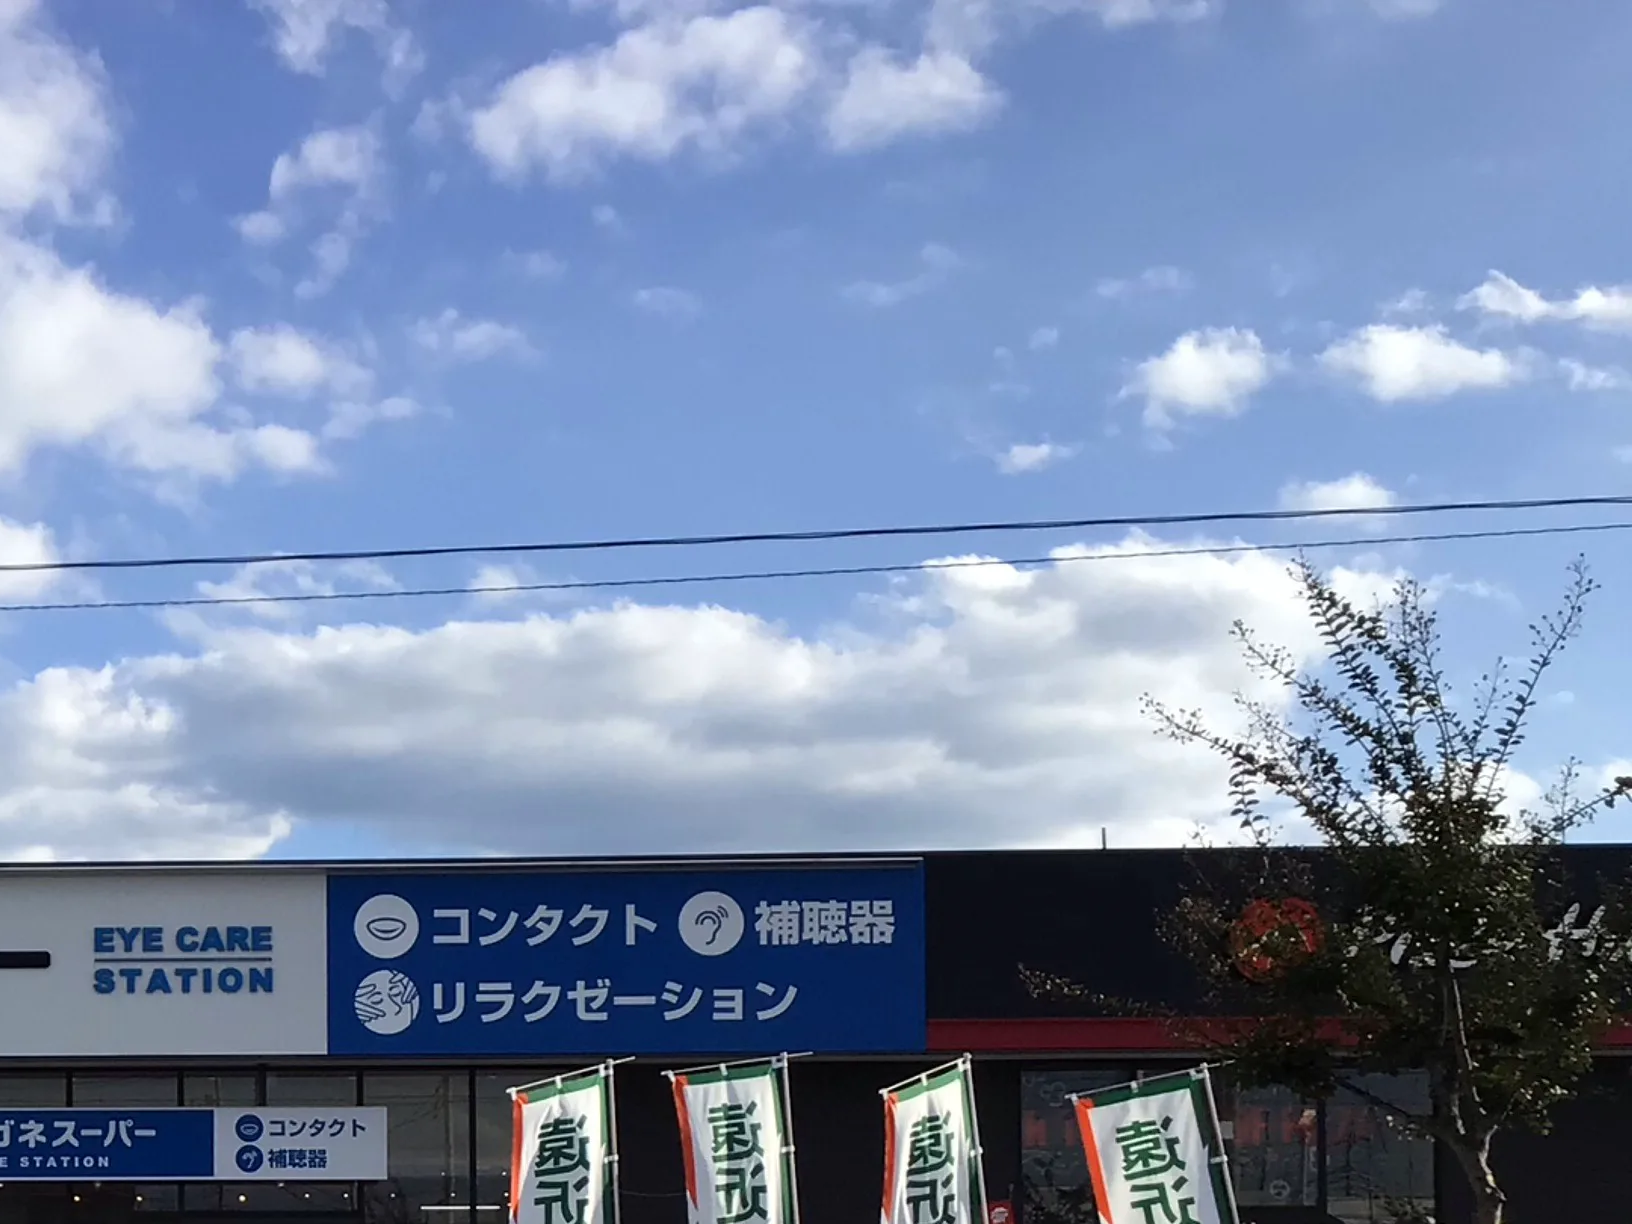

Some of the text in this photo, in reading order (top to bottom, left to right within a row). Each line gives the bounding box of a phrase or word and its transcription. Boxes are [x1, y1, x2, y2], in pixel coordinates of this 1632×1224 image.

[432, 899, 895, 946] コンタクト 補聴器
[93, 926, 273, 953] EYE CARE
[93, 967, 275, 994] STATION
[432, 978, 798, 1023] リラクゼーション
[268, 1118, 366, 1137] コンタクト
[20, 1156, 110, 1168] STATION
[268, 1149, 328, 1169] 補聴器
